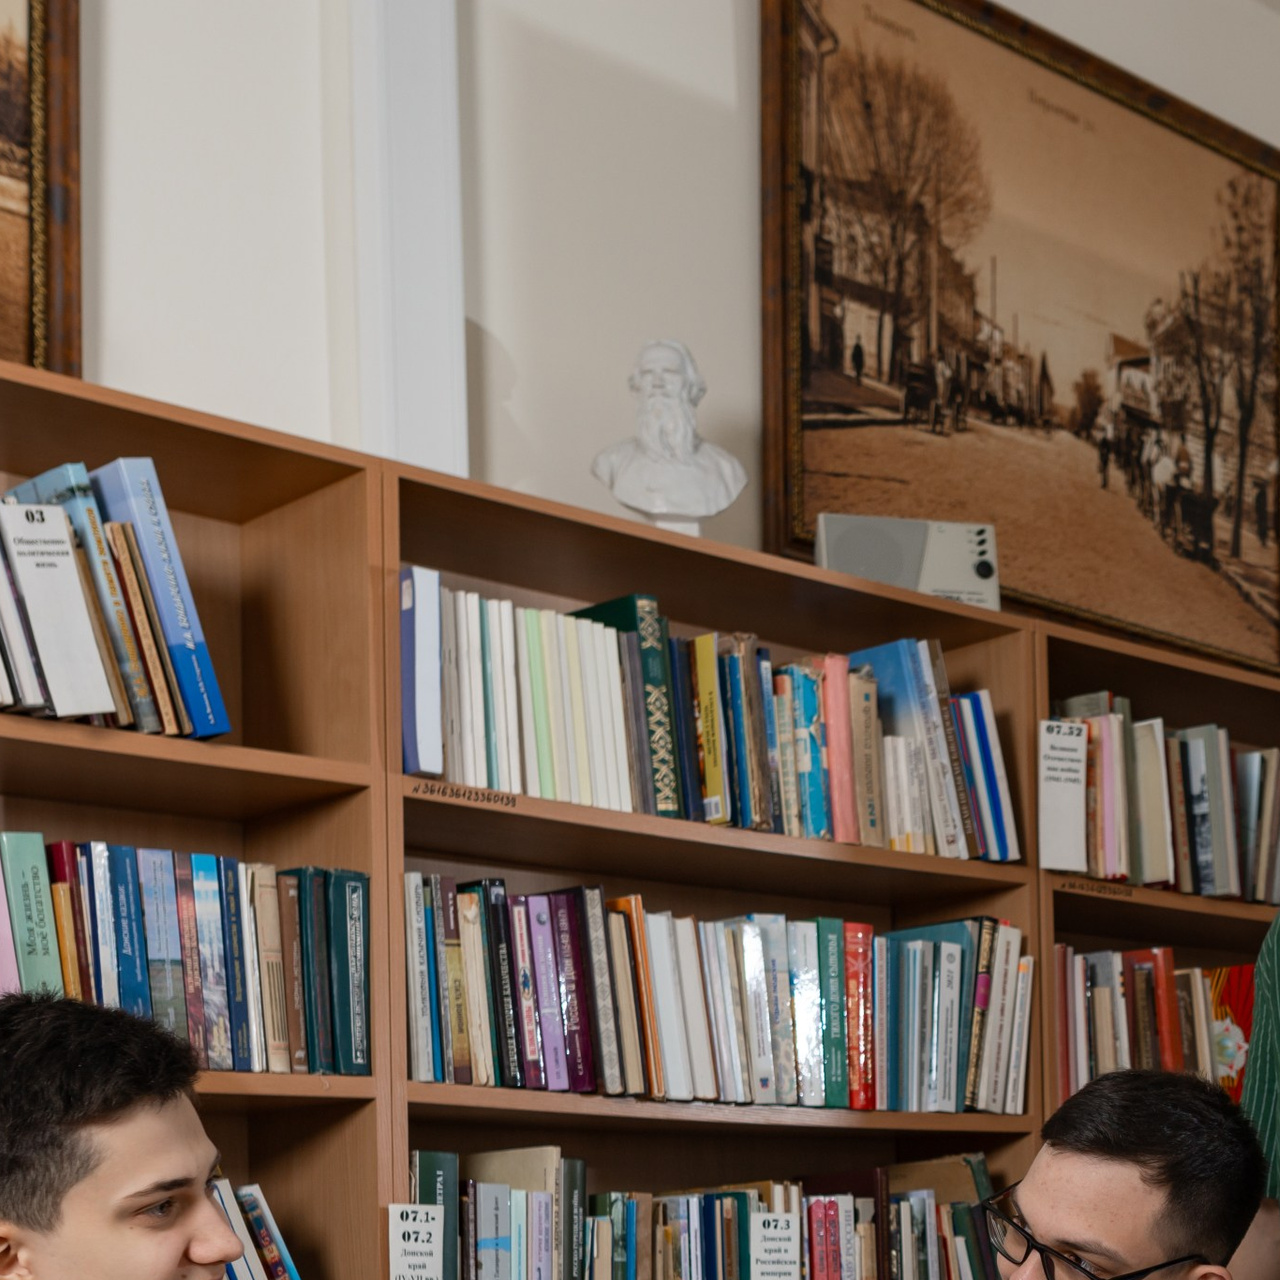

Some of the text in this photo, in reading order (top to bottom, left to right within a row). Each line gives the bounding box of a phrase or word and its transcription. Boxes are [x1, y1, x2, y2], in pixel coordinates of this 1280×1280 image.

[25, 509, 45, 523] 03
[20, 881, 32, 923] жизнь
[28, 864, 49, 957] моё богатство
[24, 926, 37, 957] Моя
[118, 917, 132, 956] Донские
[400, 1210, 435, 1223] 07.1-
[762, 1219, 790, 1230] 07.3
[402, 1231, 432, 1243] 07.2
[843, 1208, 853, 1256] РОССИИ
[256, 1227, 279, 1263] неба
[760, 1235, 791, 1243] Донской
[401, 1249, 433, 1257] Донской
[764, 1247, 782, 1255] край
[408, 1263, 426, 1271] край
[761, 1270, 792, 1278] империи
